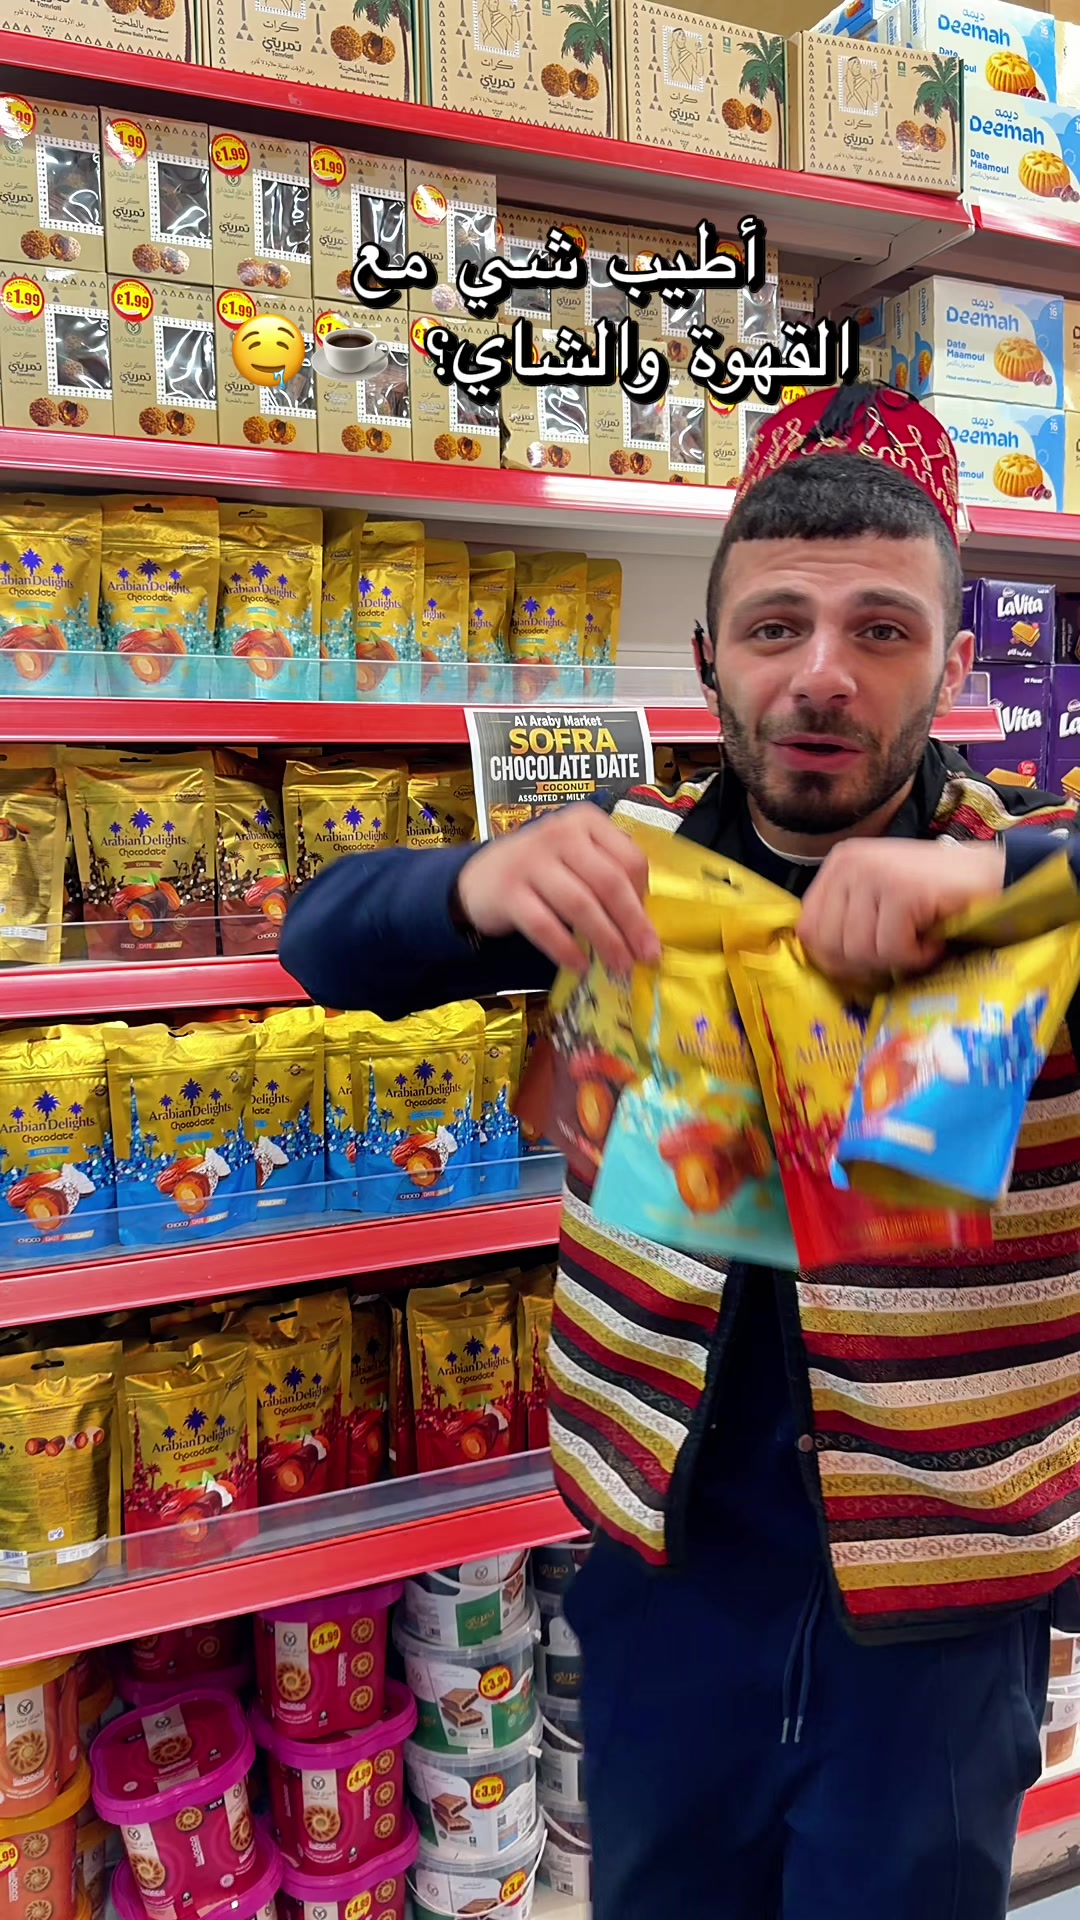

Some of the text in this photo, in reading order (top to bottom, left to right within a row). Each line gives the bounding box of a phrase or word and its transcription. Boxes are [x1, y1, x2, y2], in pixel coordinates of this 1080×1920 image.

[937, 14, 1011, 47] Deemah
[969, 115, 1044, 145] Deemah
[215, 145, 246, 162] £1.99
[970, 149, 990, 160] Date
[313, 158, 343, 174] £1.99
[970, 159, 1009, 174] Maamoul
[6, 288, 40, 307] £1.99
[116, 291, 150, 309] £1.99
[221, 300, 253, 317] £1.99
[1049, 306, 1058, 316] 16
[946, 306, 1019, 332] Deemah
[946, 339, 967, 349] Date
[946, 349, 985, 362] Maamoul
[1049, 421, 1059, 432] 16
[947, 426, 1019, 448] Deemah
[33, 575, 74, 589] Delights
[108, 580, 192, 596] Arabian Delights
[9, 587, 57, 598] Chocodate
[127, 593, 173, 603] Chocodate
[223, 584, 298, 600] Arabian Delights
[240, 594, 280, 607] Chocodate
[364, 598, 402, 611] Delights
[997, 593, 1043, 618] LaVita
[530, 617, 564, 630] Delights
[512, 627, 549, 636] Chocodate
[514, 715, 603, 729] Al Araby Market
[1002, 706, 1042, 733] Vita
[508, 727, 619, 755] SOFRA
[490, 753, 640, 781] CHOCOLATE DATE
[542, 783, 590, 791] COCONUT
[518, 793, 585, 803] ASSORTED MILK
[101, 834, 187, 847] Arabian Delights
[235, 832, 266, 842] Arabian
[315, 830, 389, 844] Arabian Delights
[410, 836, 452, 847] Chocodate
[119, 847, 167, 857] Chocodate
[332, 842, 375, 852] Chocodate
[257, 932, 278, 940] CHOCO
[385, 1082, 462, 1098] Arabian Delights
[404, 1097, 447, 1108] Chocodate
[149, 1102, 233, 1122] Arabian Delights
[0, 1117, 96, 1135] Arabian Delights
[170, 1117, 215, 1130] Chocodate
[22, 1132, 75, 1144] Chocodate
[400, 1192, 420, 1200] CHOCO
[166, 1220, 189, 1229] CHOCO
[437, 1356, 511, 1377] Arabian Delights
[455, 1371, 495, 1384] Chocodate
[273, 1402, 316, 1416] Chocodate
[152, 1425, 236, 1454] Arabian Delights
[173, 1444, 221, 1461] Chocodate
[311, 1628, 339, 1649] £4.99
[482, 1671, 508, 1693] £3.99
[475, 1783, 502, 1799] £3.99
[209, 1798, 223, 1809] NEW
